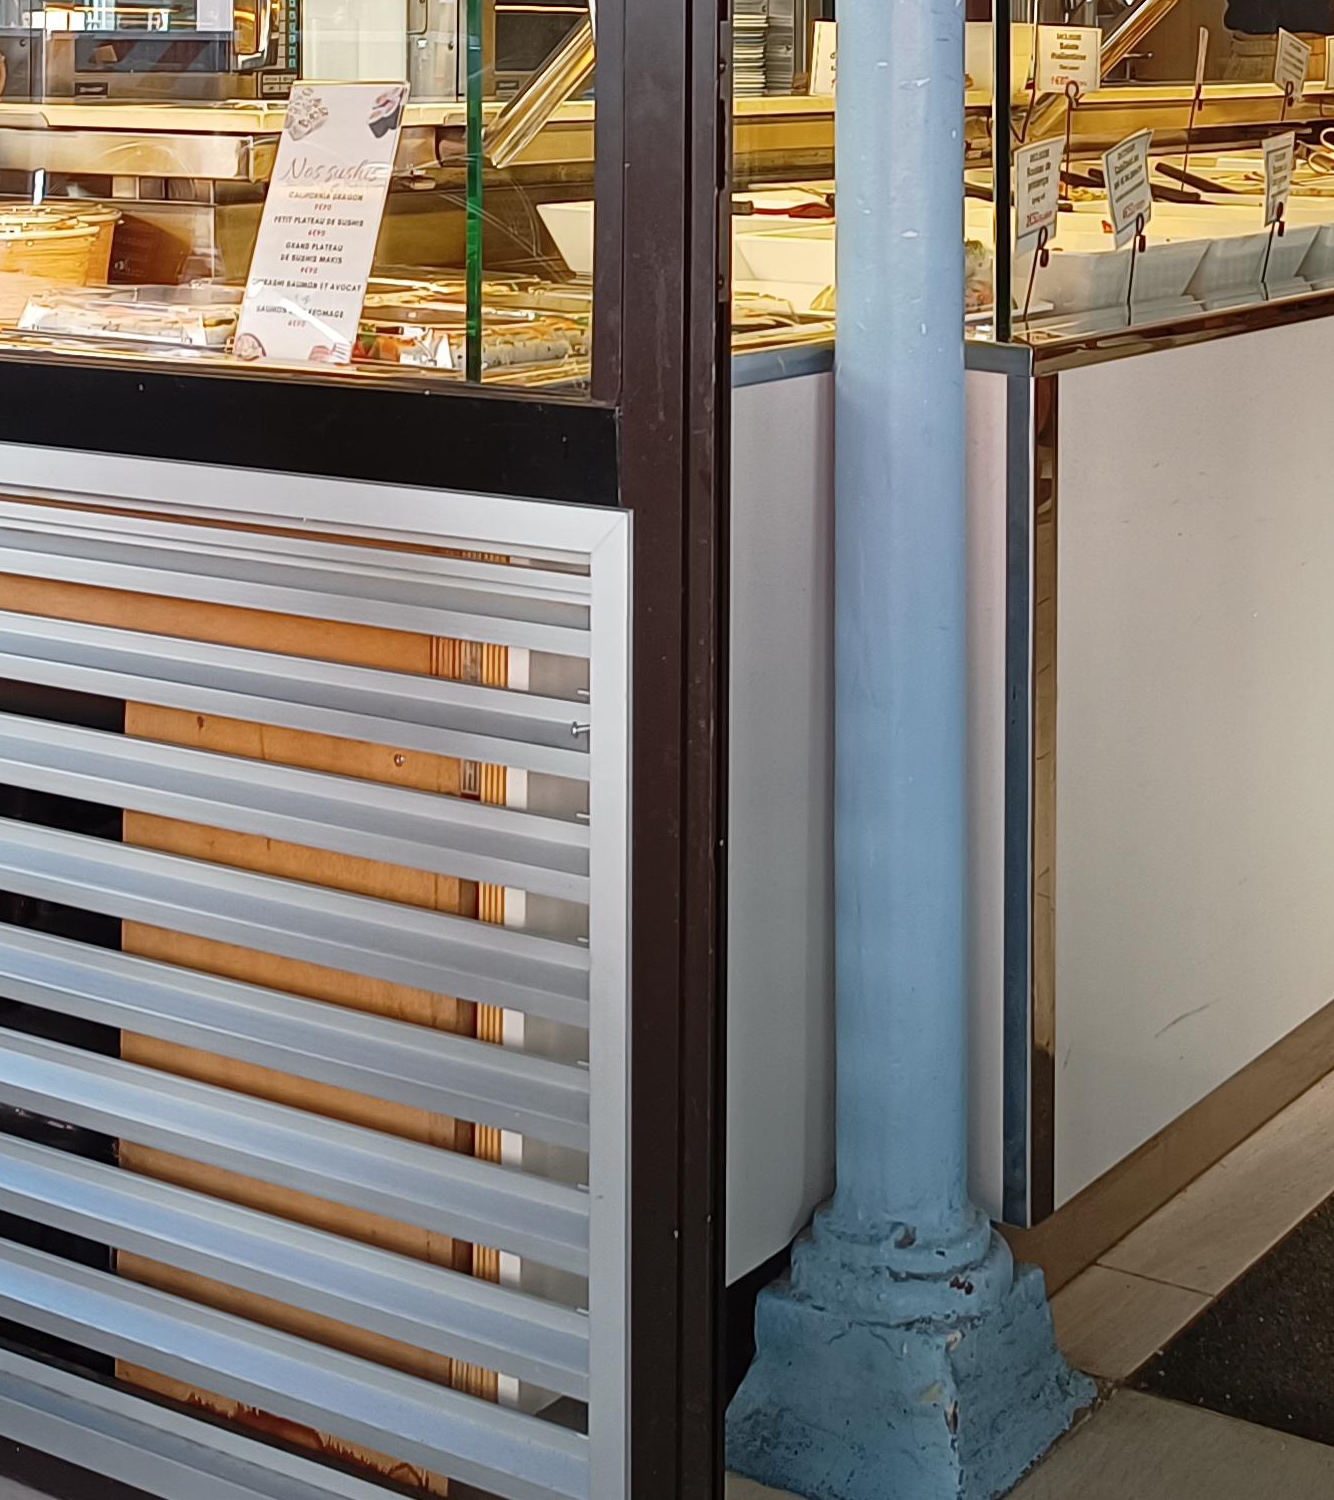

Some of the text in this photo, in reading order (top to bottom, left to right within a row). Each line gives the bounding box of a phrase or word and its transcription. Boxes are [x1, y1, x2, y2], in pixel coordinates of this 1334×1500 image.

[278, 157, 325, 181] Nos
[274, 215, 293, 223] PETIT
[294, 216, 326, 225] PLATEAU
[286, 241, 343, 252] GRAND PLATEAU
[319, 256, 342, 264] MAKIS
[320, 281, 328, 290] ET
[329, 284, 362, 292] AVOCAT
